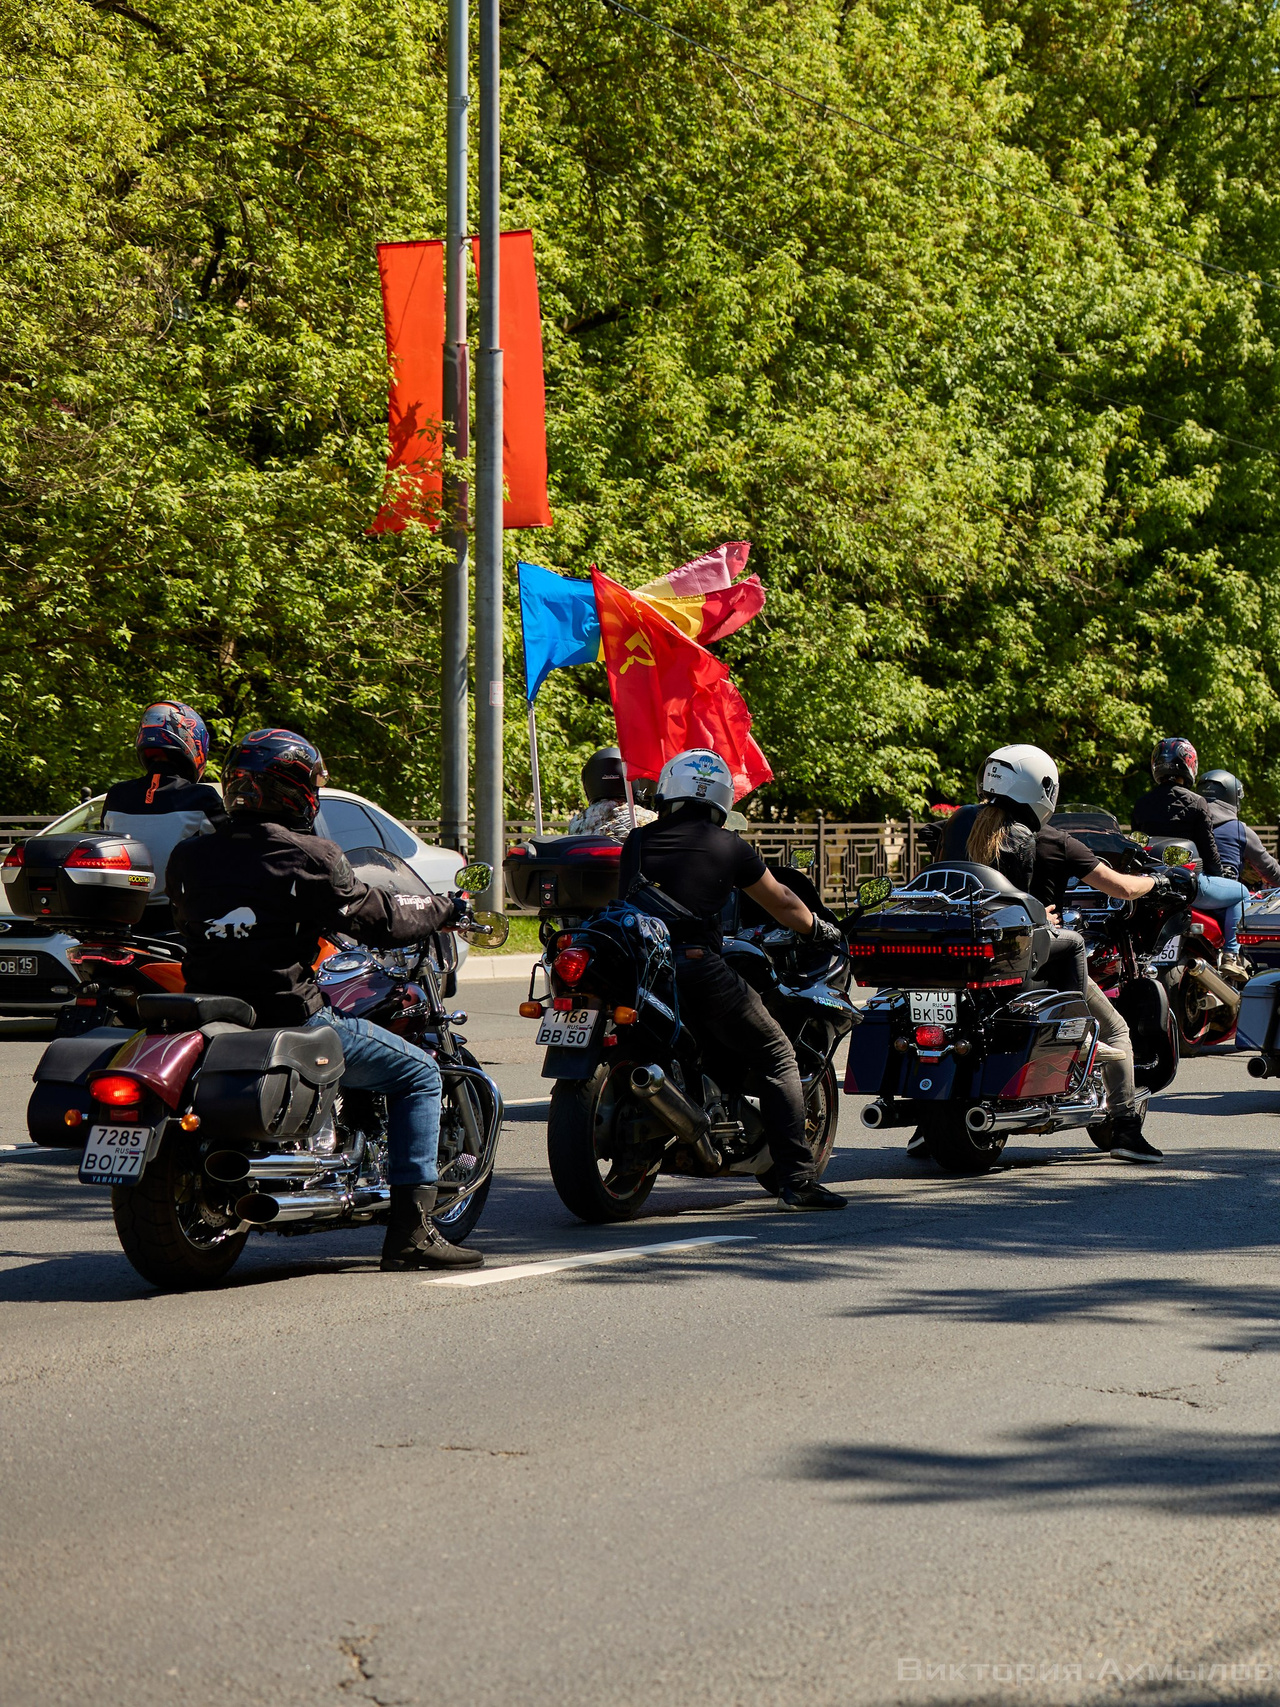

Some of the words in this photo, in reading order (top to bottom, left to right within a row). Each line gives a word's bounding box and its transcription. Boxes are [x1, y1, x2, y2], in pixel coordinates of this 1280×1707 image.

[1161, 949, 1175, 960] 50
[20, 958, 33, 969] 15
[552, 1010, 589, 1024] 1168
[937, 1009, 954, 1022] 50
[566, 1031, 586, 1044] 50
[97, 1129, 142, 1147] 7285
[115, 1147, 130, 1155] RUS
[117, 1156, 140, 1173] 77
[92, 1175, 123, 1184] YAMAHA
